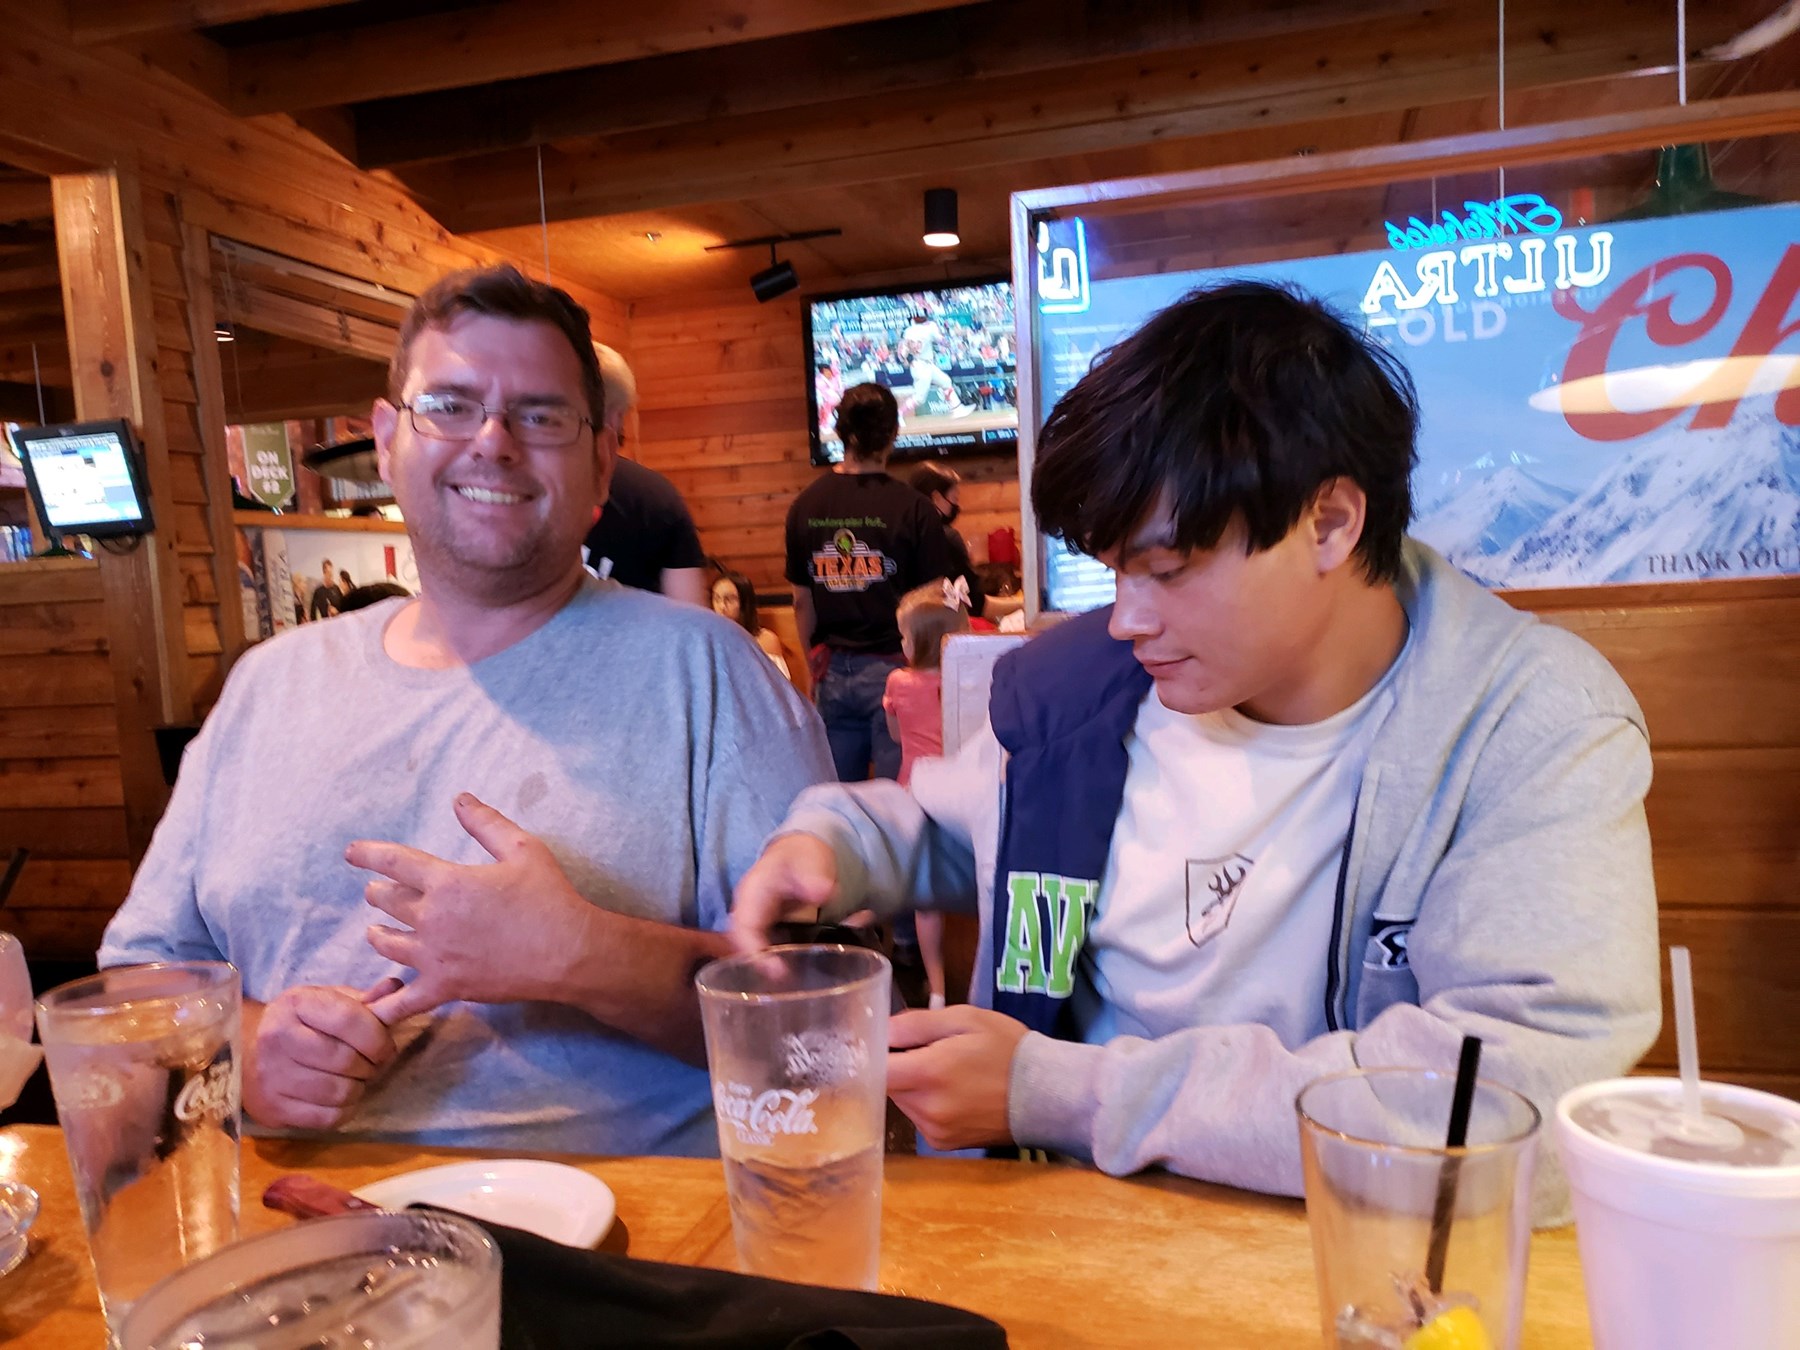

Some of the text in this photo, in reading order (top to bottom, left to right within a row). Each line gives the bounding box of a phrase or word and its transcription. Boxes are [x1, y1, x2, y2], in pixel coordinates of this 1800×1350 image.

[256, 450, 279, 465] ON
[251, 464, 290, 480] DECK
[813, 553, 883, 577] TEXAS
[1645, 549, 1731, 574] THANK
[1737, 546, 1789, 571] YOU
